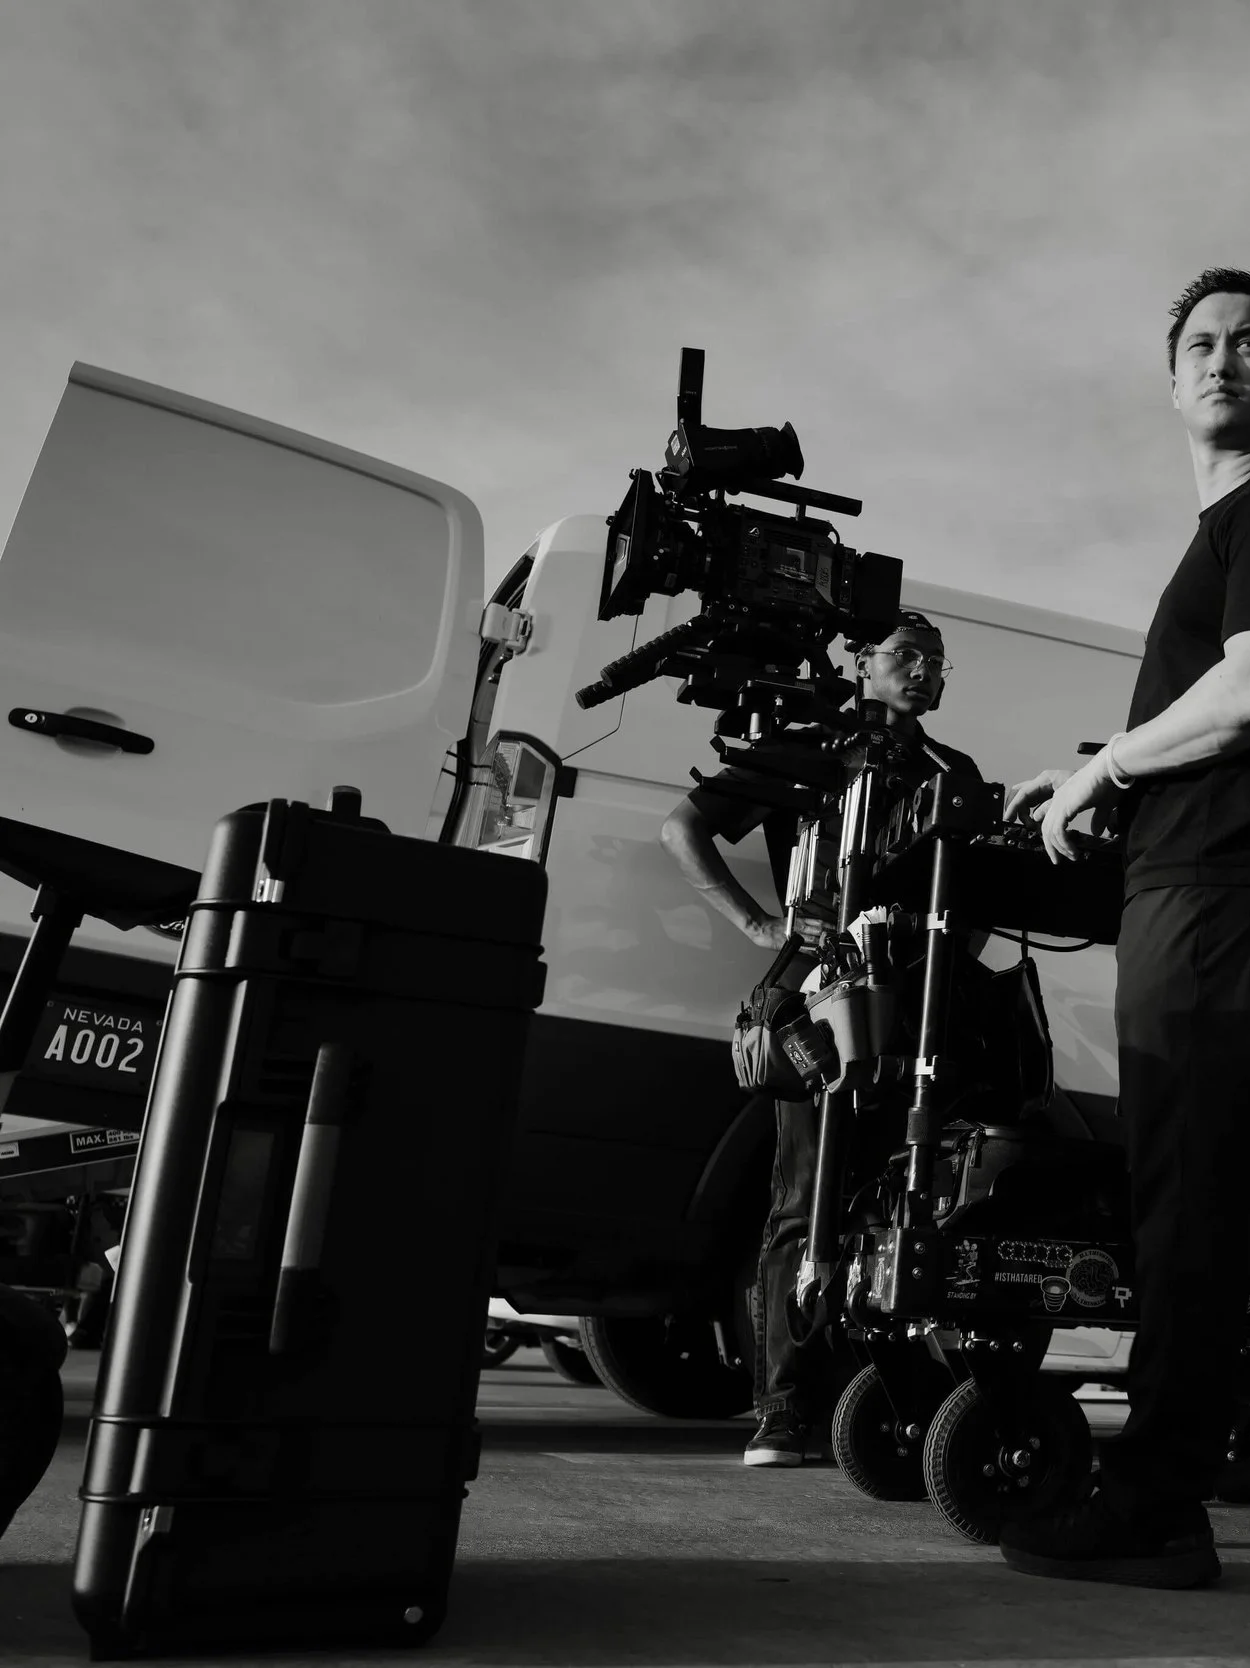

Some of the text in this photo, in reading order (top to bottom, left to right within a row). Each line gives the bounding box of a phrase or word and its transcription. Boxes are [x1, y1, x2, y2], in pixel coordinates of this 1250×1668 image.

[63, 1008, 143, 1033] NEVADA
[44, 1024, 144, 1073] A002
[75, 1134, 105, 1147] MAX.
[994, 1271, 1042, 1284] #ISTHATARED
